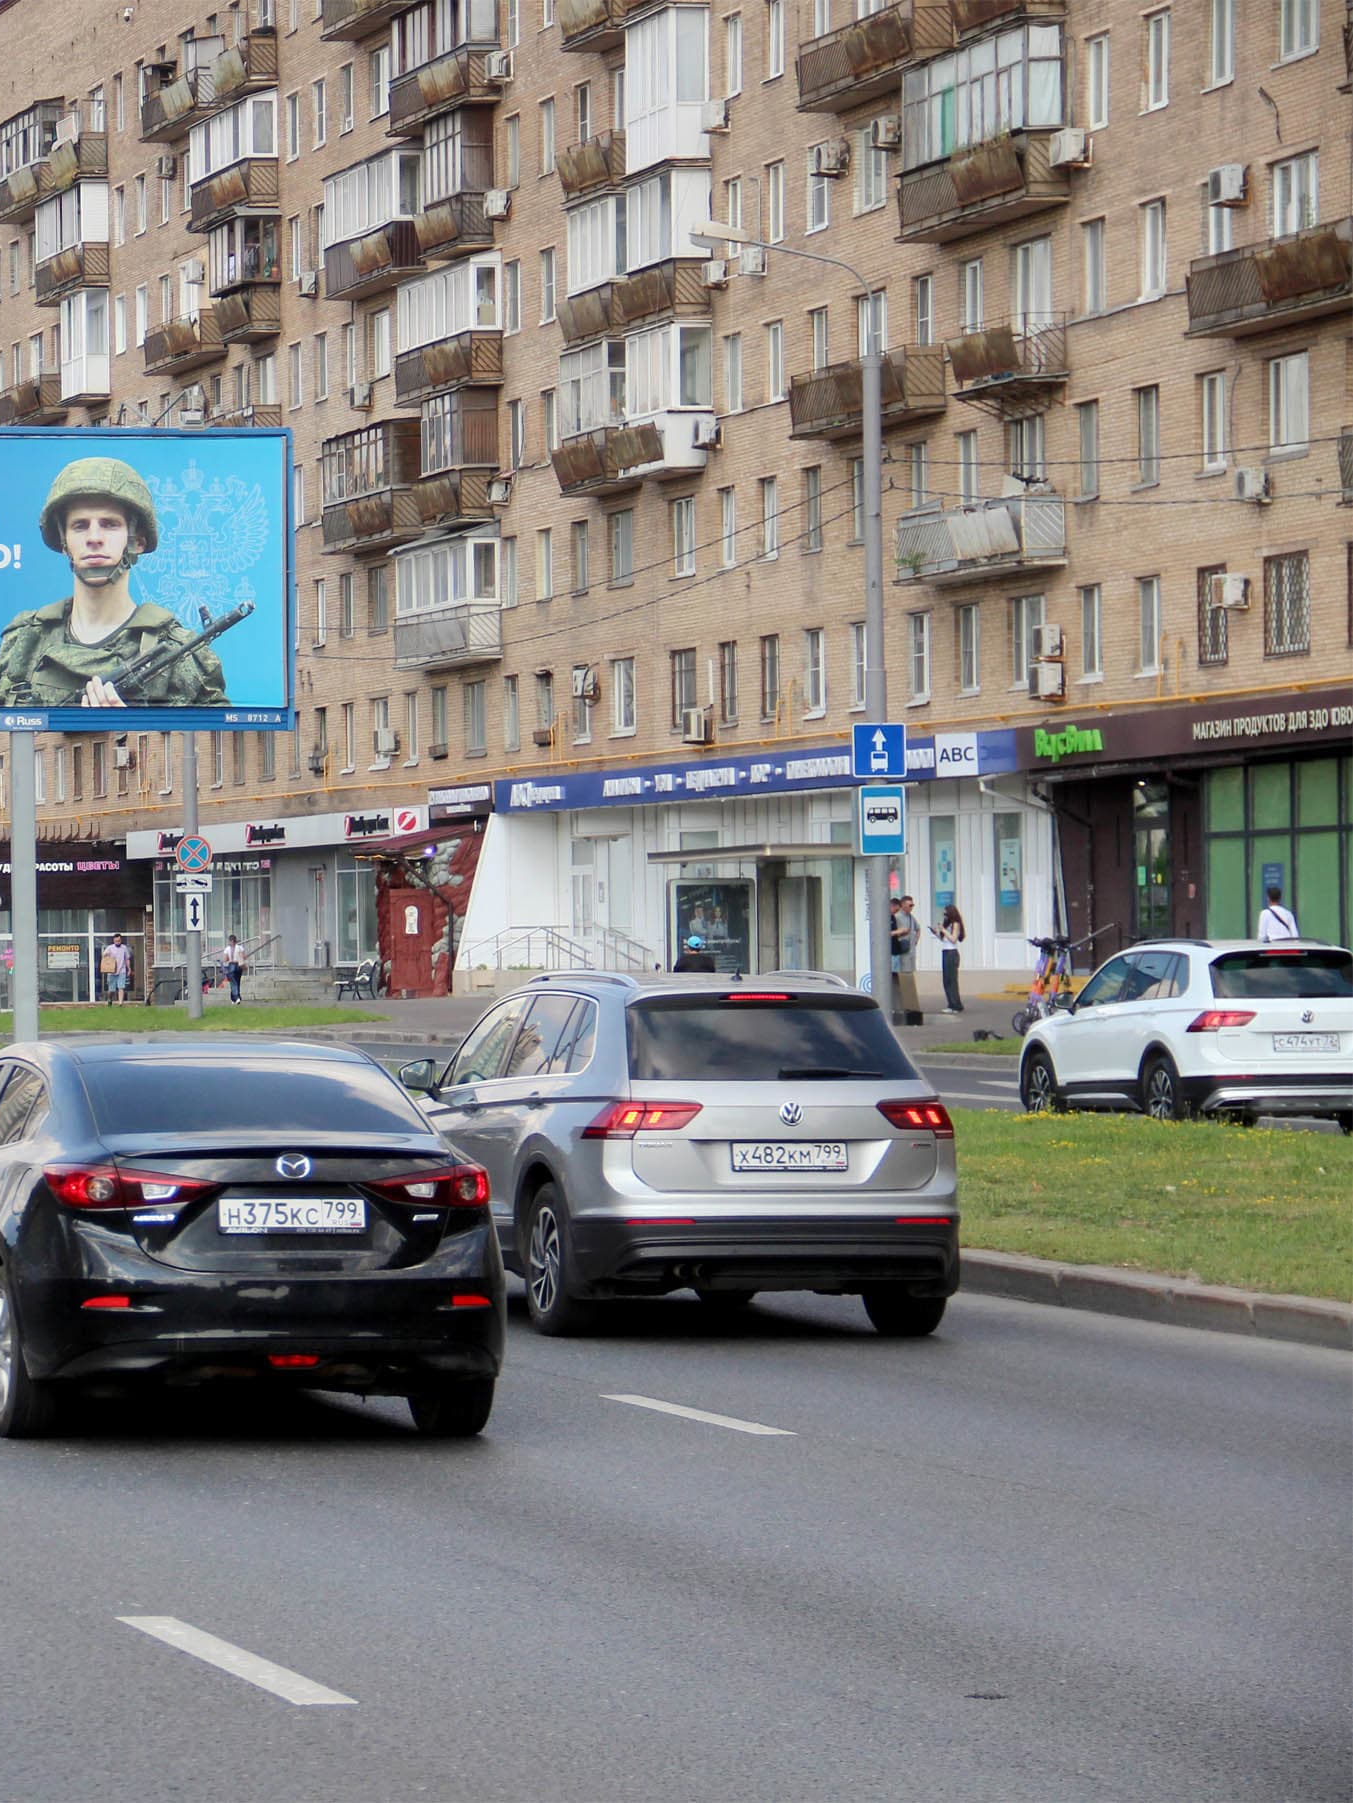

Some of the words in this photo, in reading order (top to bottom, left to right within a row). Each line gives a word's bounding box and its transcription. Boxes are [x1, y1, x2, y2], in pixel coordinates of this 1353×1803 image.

[16, 716, 42, 726] Russ
[1193, 718, 1232, 740] МАГАЗИН
[1233, 714, 1286, 738] ПРОДУКТОВ
[1287, 711, 1308, 734] ДЛЯ
[34, 862, 74, 872] РАСОТЫ
[76, 860, 120, 872] ЦВЕТЫ
[814, 1145, 841, 1159] 799
[324, 1201, 358, 1219] 799
